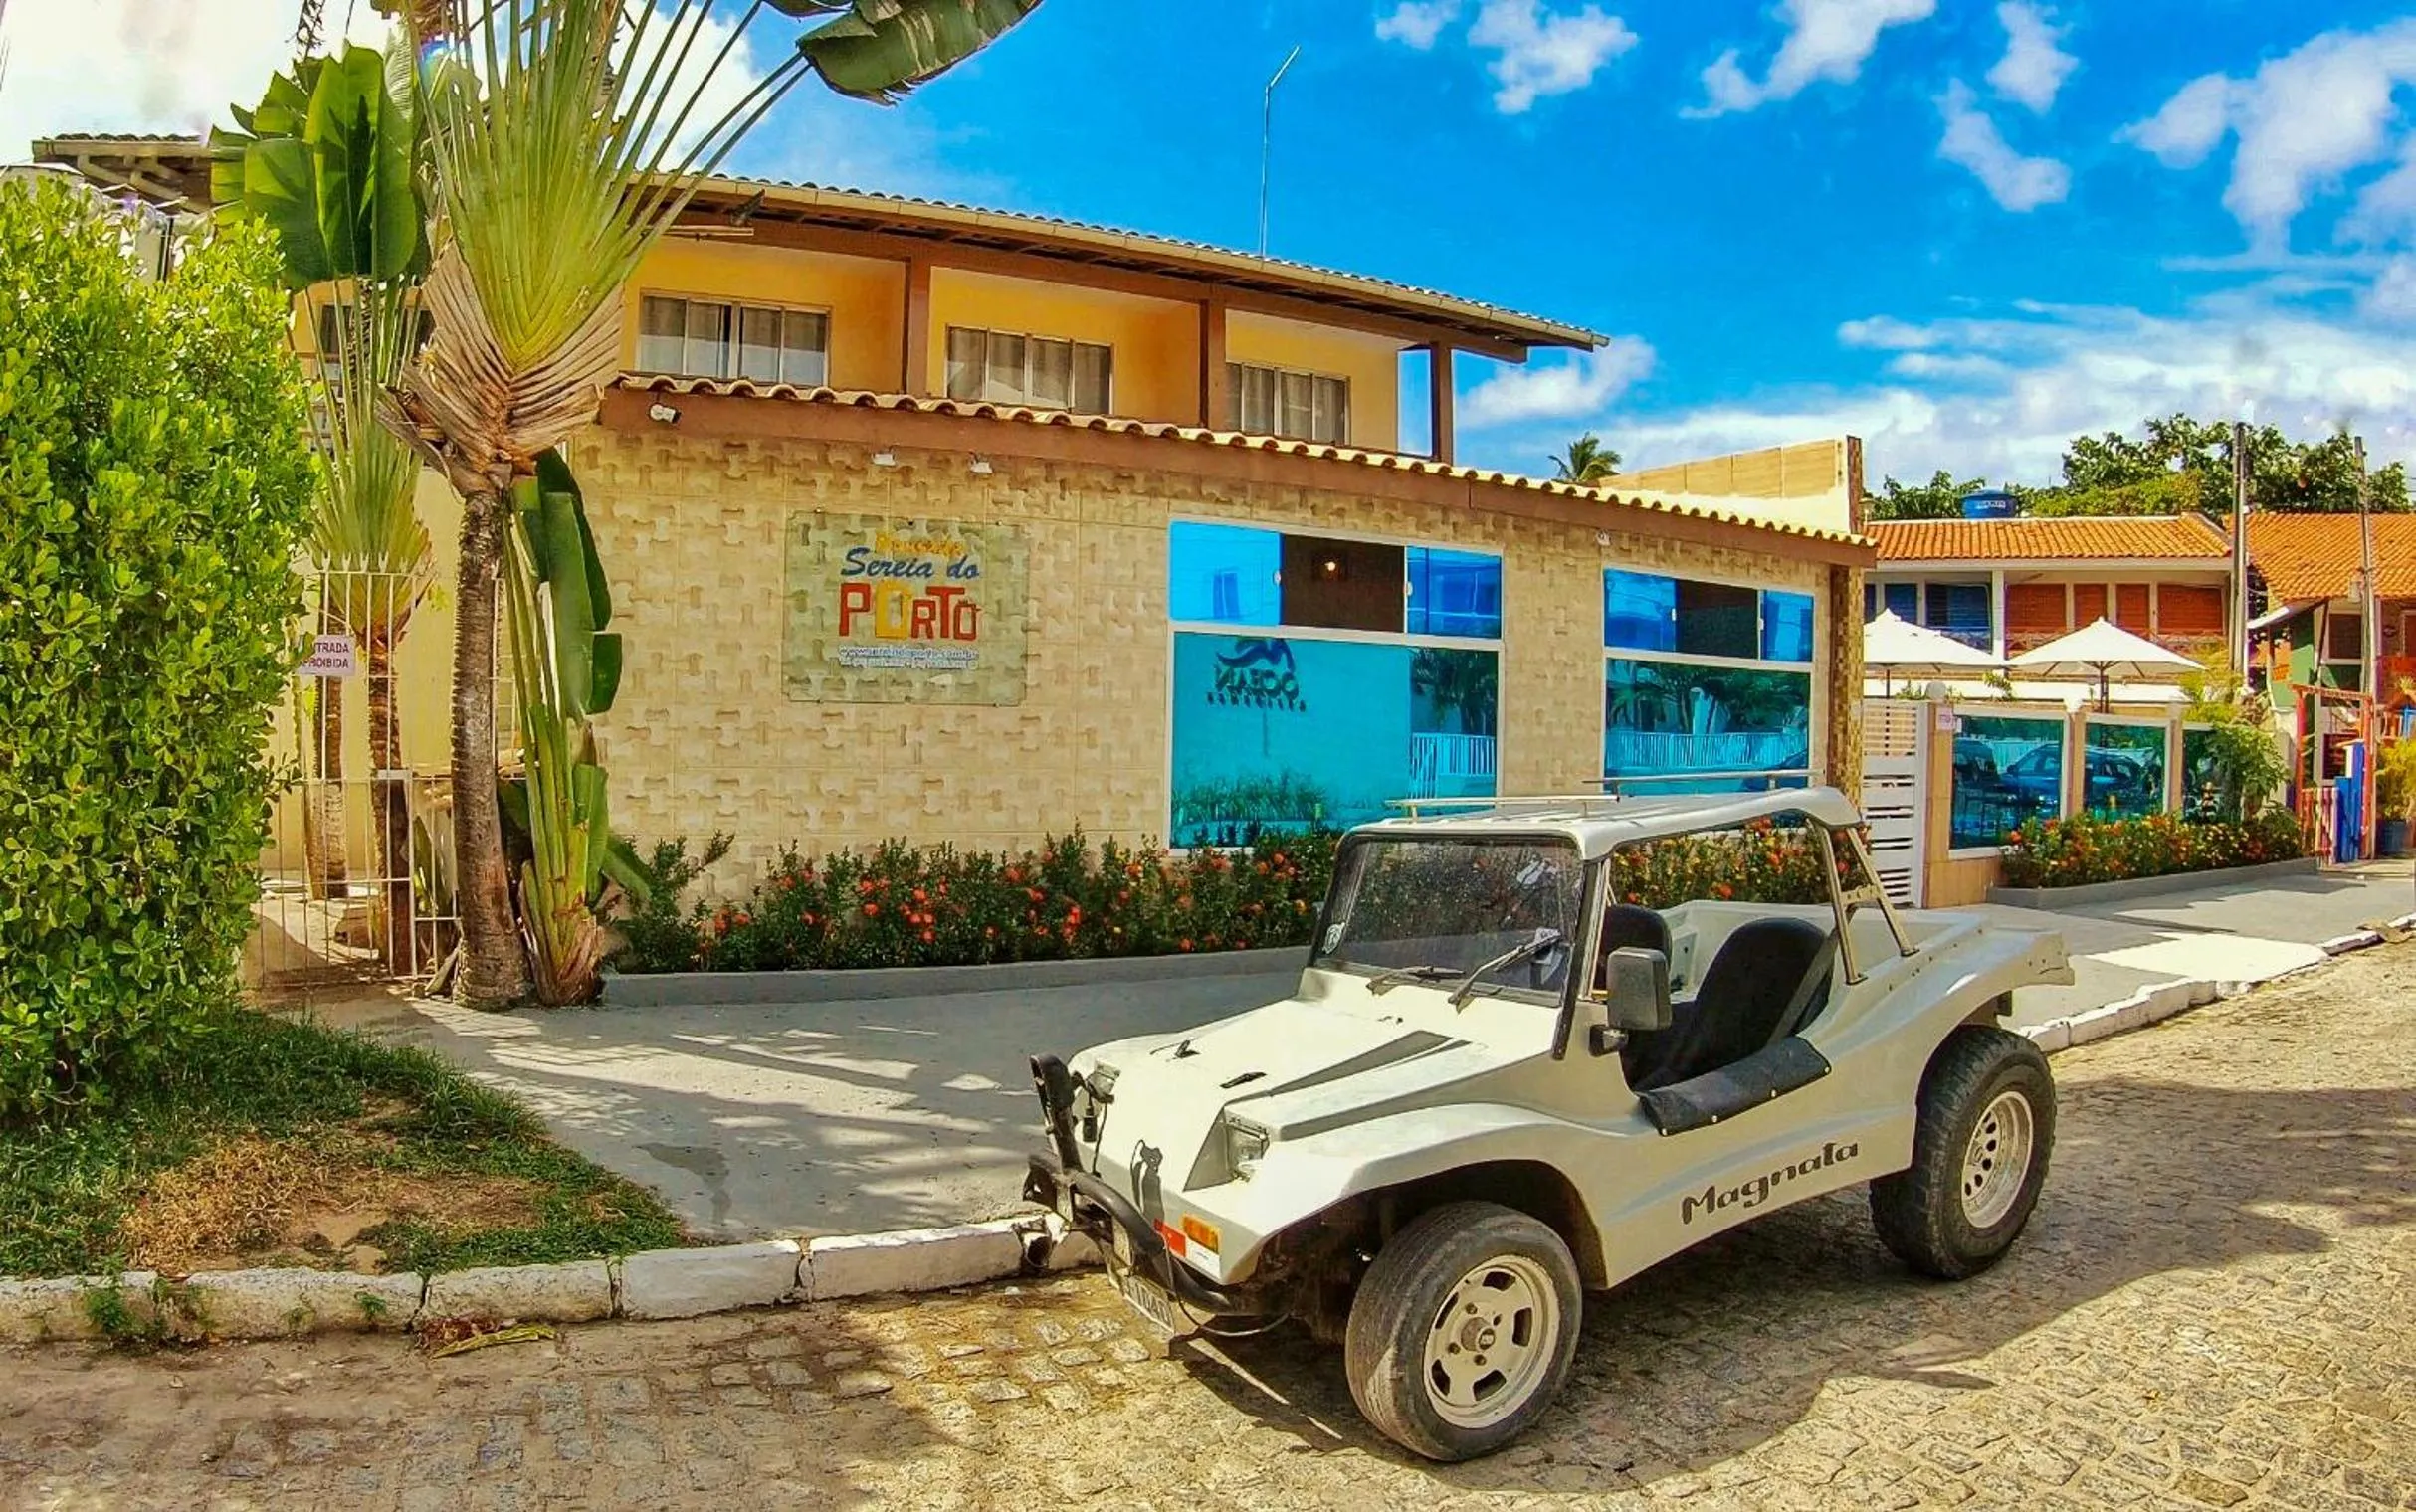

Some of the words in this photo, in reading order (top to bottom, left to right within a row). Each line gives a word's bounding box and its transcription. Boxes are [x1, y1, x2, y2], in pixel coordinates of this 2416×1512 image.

[841, 547, 934, 577] Sereia
[946, 555, 979, 579] do
[838, 580, 981, 641] PORTO
[314, 642, 349, 653] TRADA
[1682, 1142, 1859, 1225] Magnata
